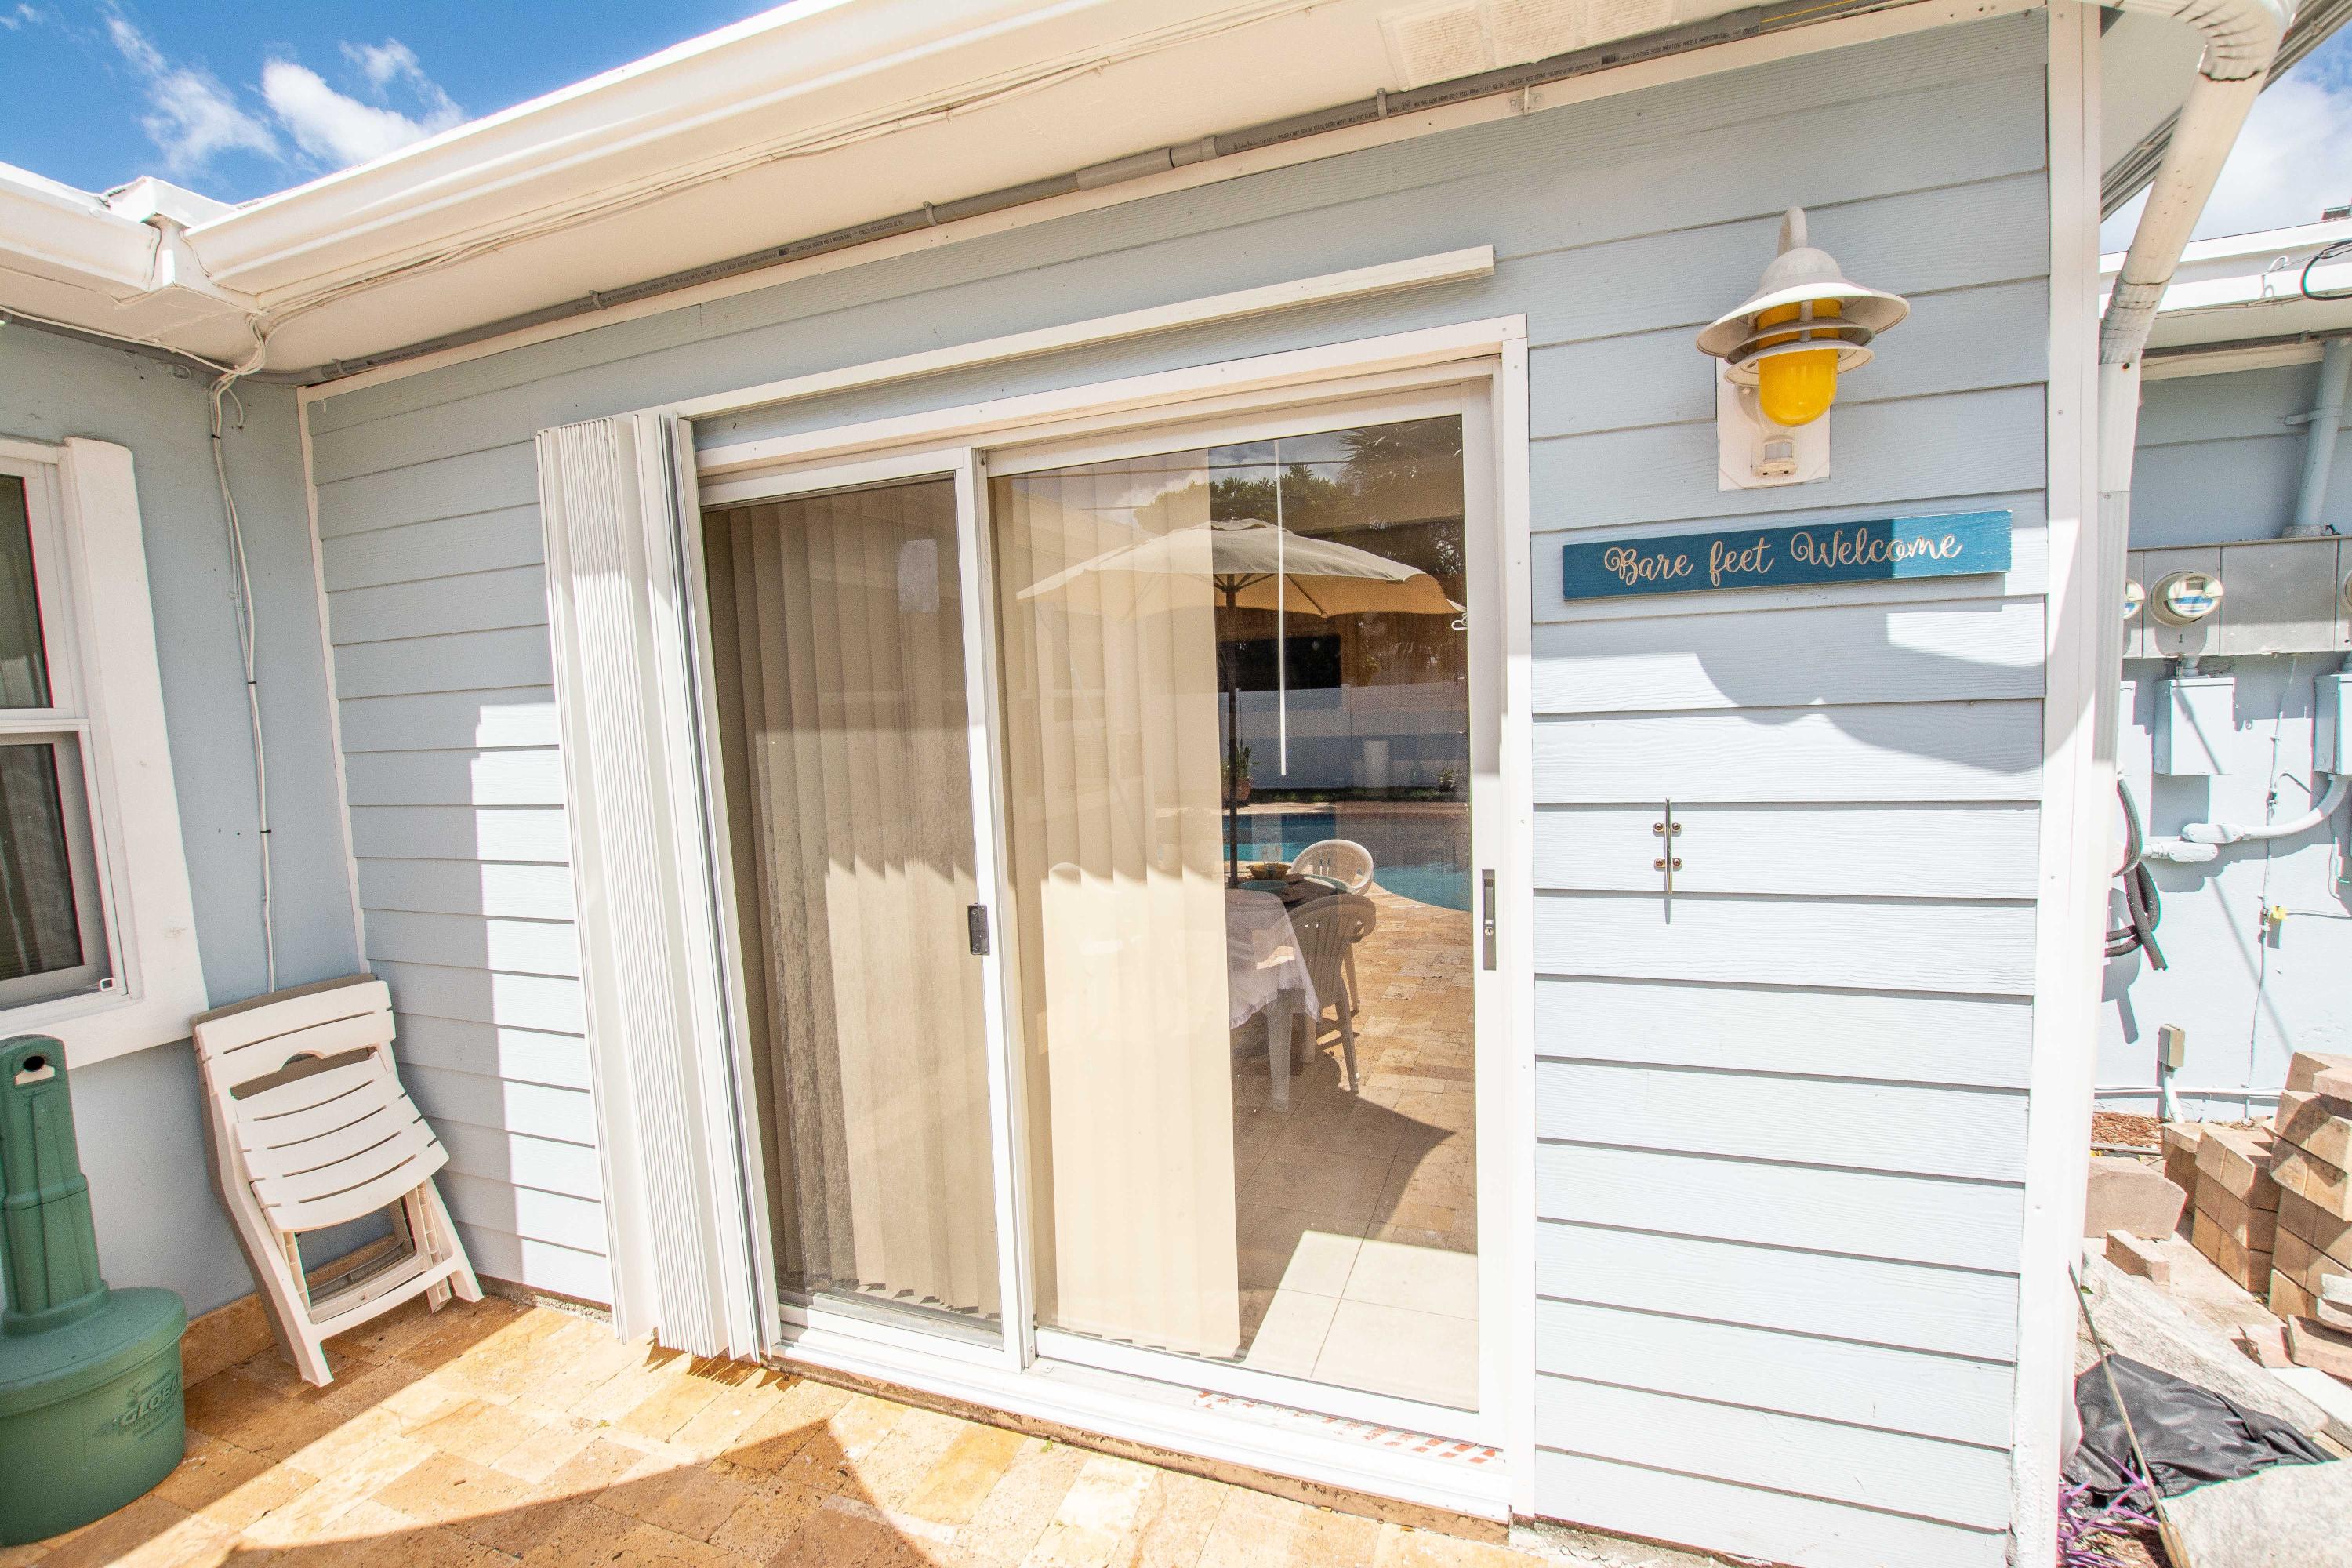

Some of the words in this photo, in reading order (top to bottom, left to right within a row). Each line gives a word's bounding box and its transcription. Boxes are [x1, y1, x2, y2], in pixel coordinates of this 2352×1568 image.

[1604, 546, 1693, 586] Bare
[1710, 537, 1774, 587] feet
[1791, 528, 1962, 568] Welcome
[120, 1372, 180, 1427] GLOBA
